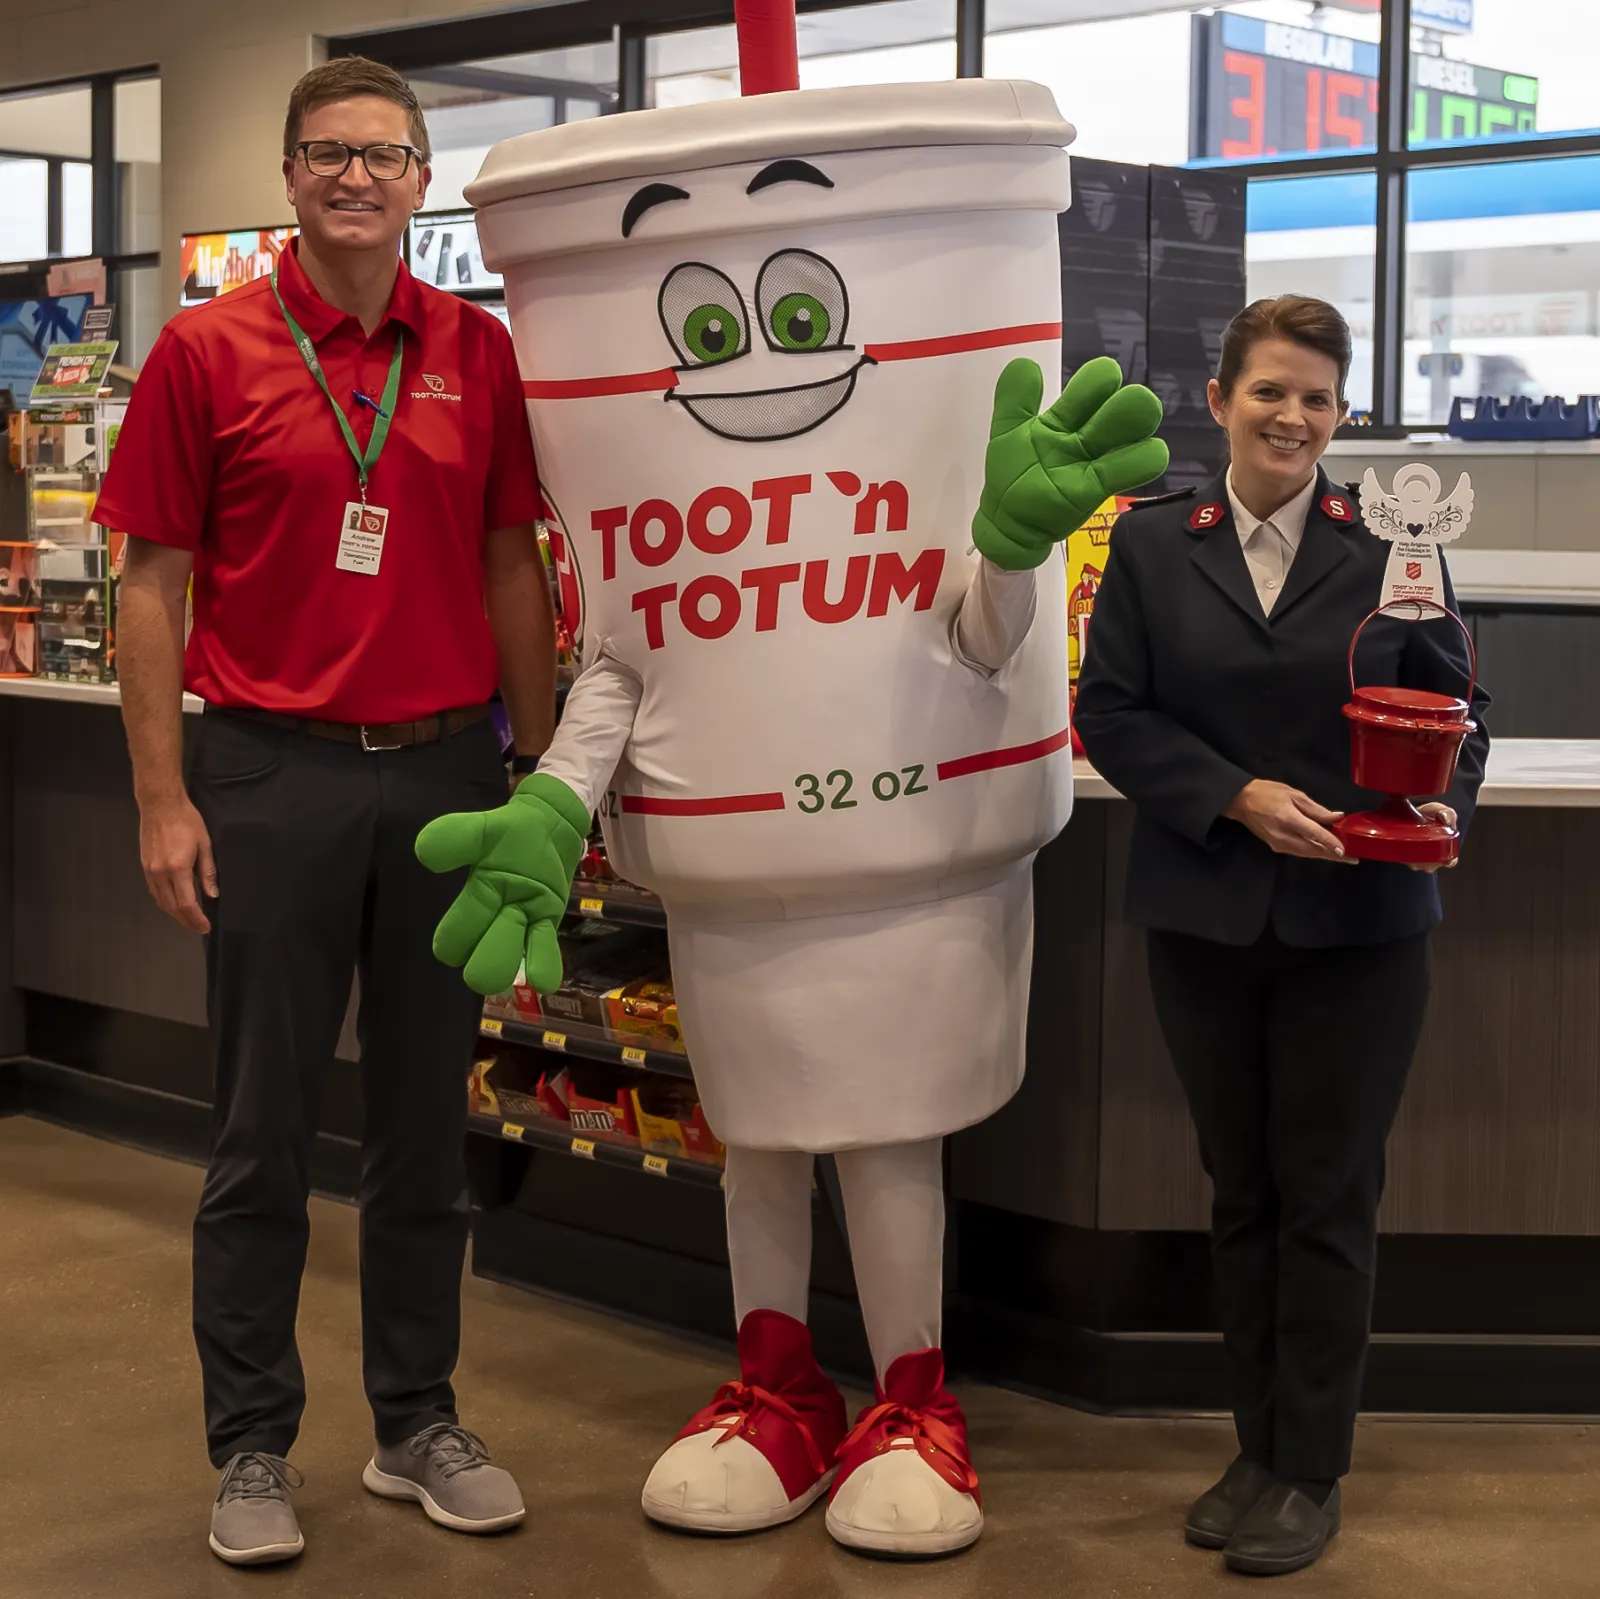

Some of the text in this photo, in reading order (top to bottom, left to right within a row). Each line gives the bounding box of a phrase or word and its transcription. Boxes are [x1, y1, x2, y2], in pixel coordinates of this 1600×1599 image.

[1265, 22, 1353, 72] REGULAR
[1417, 54, 1478, 96] DIESEL
[437, 393, 461, 401] TOTUM
[1199, 507, 1215, 524] S
[1329, 500, 1345, 516] S
[351, 534, 376, 543] Andrew
[590, 474, 812, 581] TOOT
[344, 551, 371, 561] Operations
[631, 548, 946, 650] TOTUM
[794, 769, 858, 814] 32
